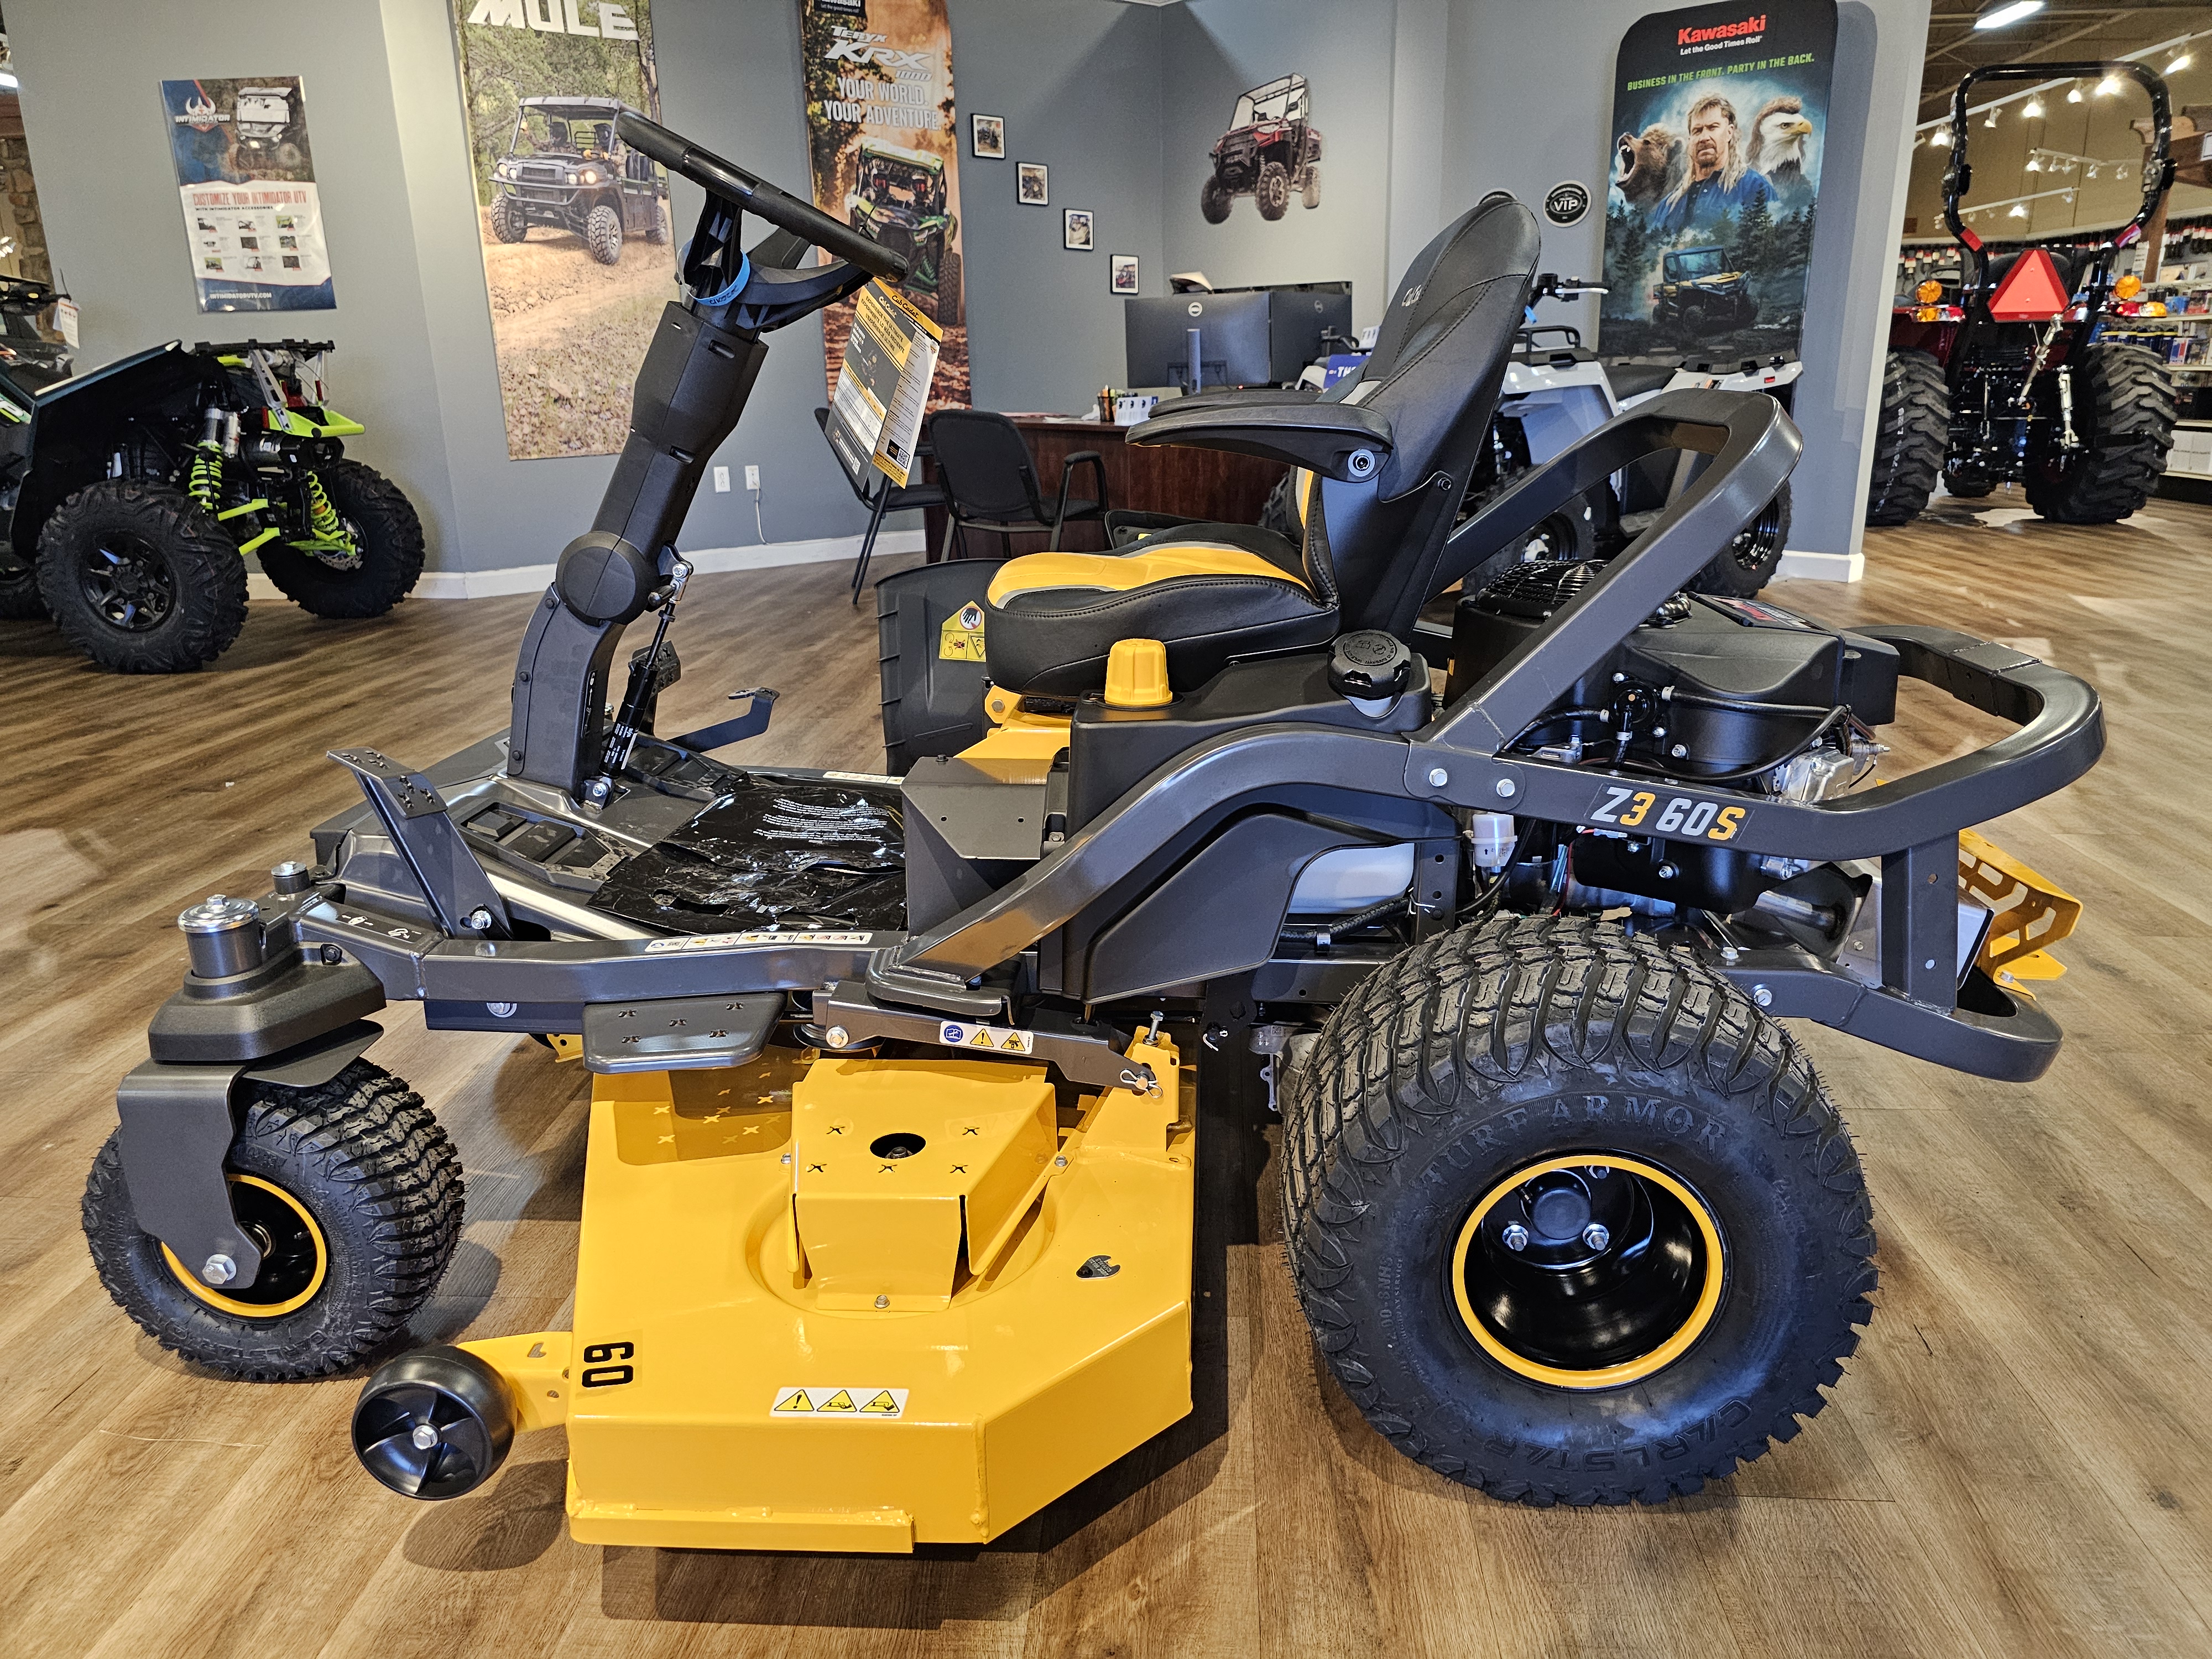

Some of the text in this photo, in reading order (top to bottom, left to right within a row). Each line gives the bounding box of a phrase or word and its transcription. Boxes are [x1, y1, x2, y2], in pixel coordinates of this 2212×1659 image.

[467, 0, 639, 40] MULE
[831, 25, 887, 44] TERYX
[1678, 14, 1766, 45] Kawasaki
[824, 39, 933, 71] KRX
[1704, 42, 1723, 51] Good
[1724, 39, 1745, 48] Times
[1627, 53, 1815, 91] BUSINESS IN THE FRONT. PARTY IN THE BACK.
[837, 77, 928, 106] YOUR WORLD.
[824, 100, 942, 131] YOUR ADVENTURE.
[194, 191, 306, 206] CUSTOMIZE YOUR INTIMIDATOR UTV
[1554, 200, 1578, 211] VIP
[866, 296, 883, 318] EXPERIENCE
[889, 323, 904, 342] ULTIMATE
[885, 304, 897, 319] Cadet
[892, 295, 919, 319] Cub Cadet
[1338, 366, 1357, 377] TH
[1590, 786, 1746, 841] Z3 60S
[1419, 1094, 1726, 1187] TURF ARMOR
[1394, 1256, 1404, 1296] SERVICE
[582, 1341, 634, 1389] 60
[1484, 1400, 1752, 1473] CARLSTAR
